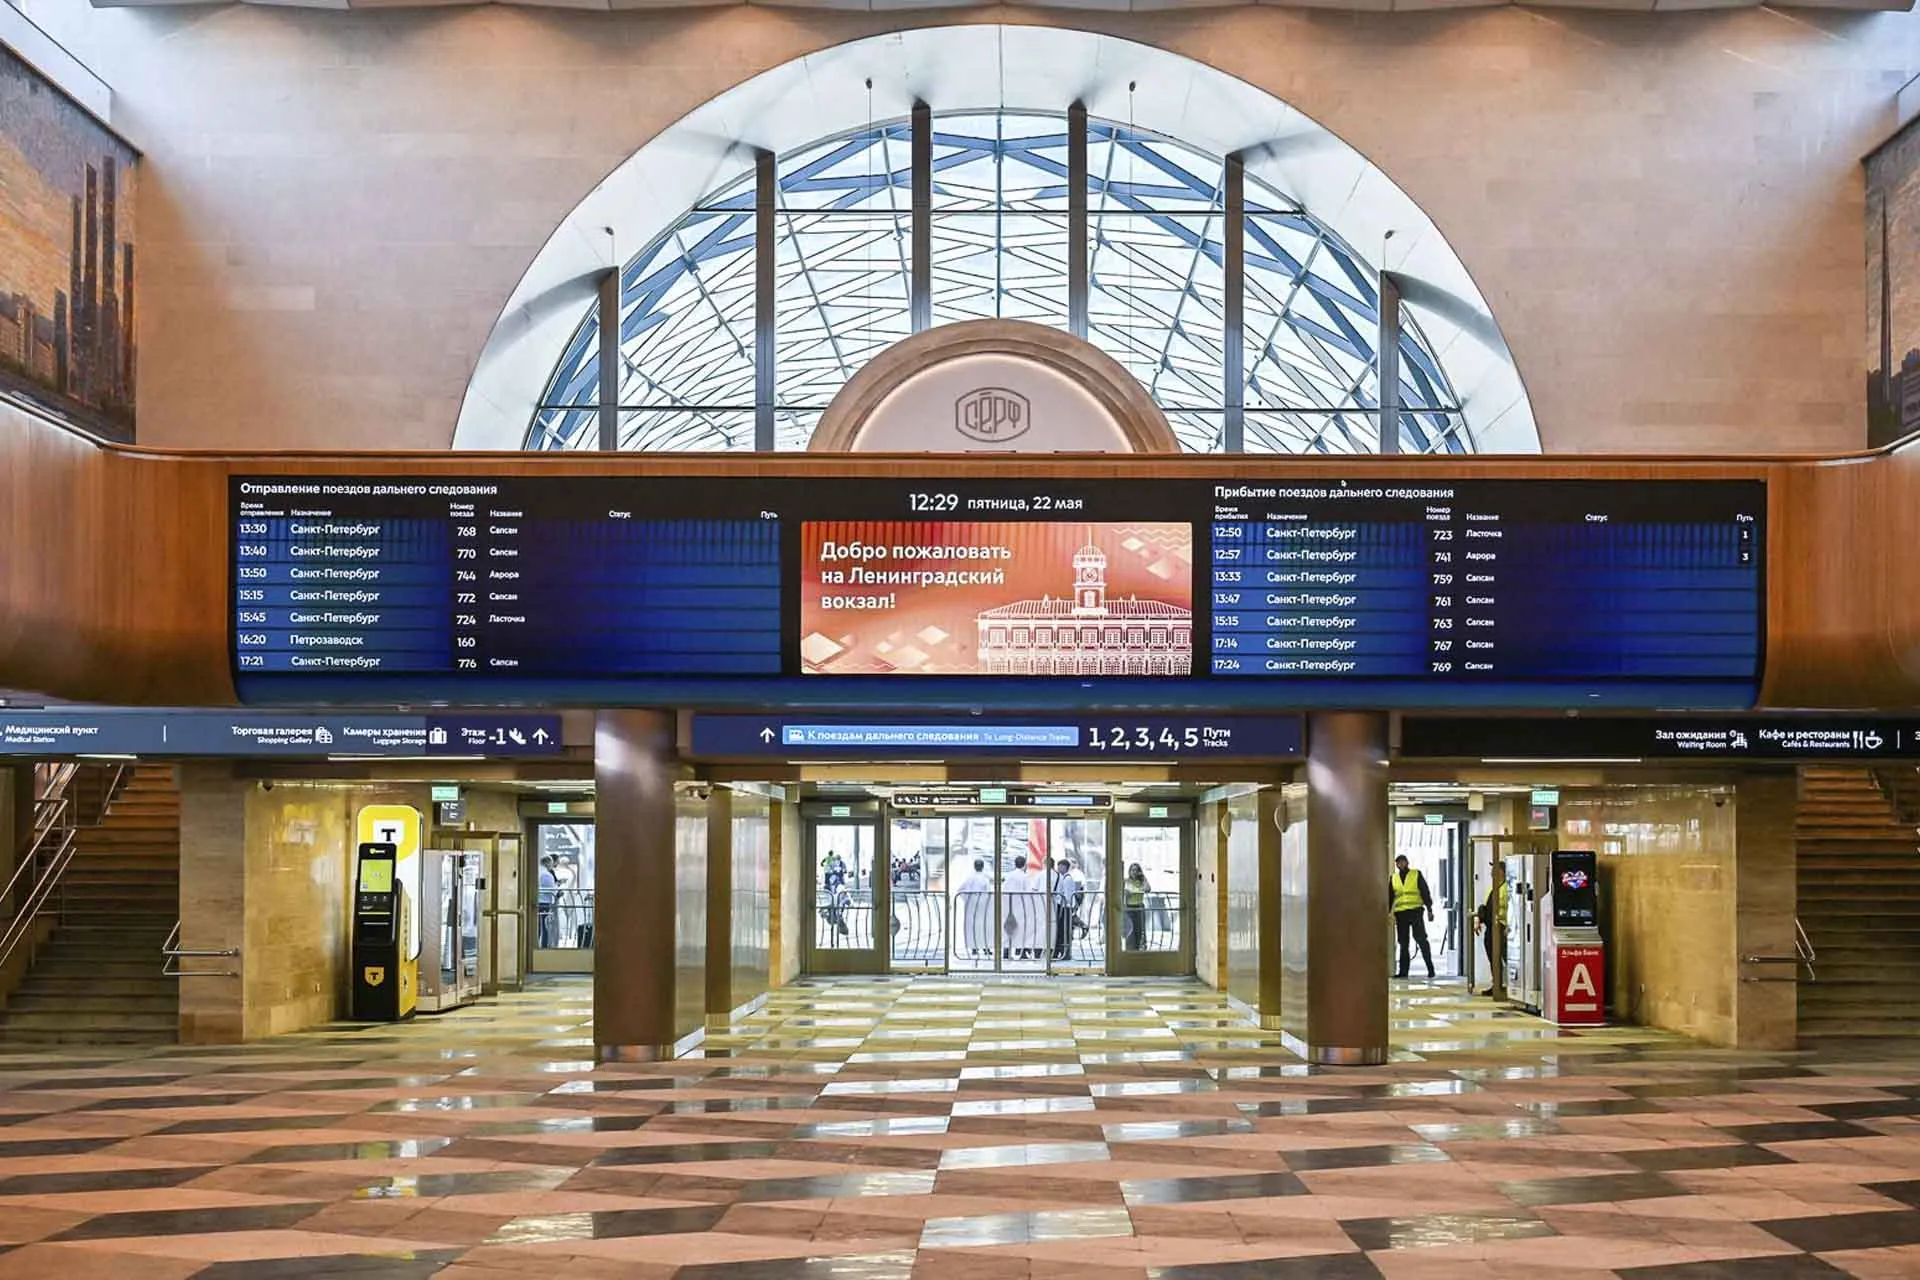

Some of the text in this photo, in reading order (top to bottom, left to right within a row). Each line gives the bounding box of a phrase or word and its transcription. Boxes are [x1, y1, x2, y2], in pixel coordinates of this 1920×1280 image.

[241, 483, 497, 495] Отправление поездов дальнего следования
[1215, 486, 1453, 499] Прибытие поездов дальнего следования
[910, 494, 958, 510] 12:29
[968, 496, 1082, 510] пятница, 22 мая
[1427, 507, 1451, 516] Номер
[240, 524, 267, 533] 13:30
[291, 524, 380, 535] Санкт-Петербург
[458, 527, 476, 536] 768
[490, 526, 517, 534] Сапсан
[1215, 528, 1242, 537] 12:50
[1267, 528, 1356, 539] Санкт-Петербург
[1434, 531, 1452, 540] 723
[240, 546, 266, 555] 13:40
[291, 546, 379, 558] Санкт-Петербург
[457, 549, 476, 558] 770
[490, 548, 517, 556] Сапсан
[821, 542, 1012, 562] Добро пожаловать
[1215, 550, 1240, 559] 12:57
[1267, 550, 1356, 561] Санкт-Петербург
[1435, 552, 1451, 562] 741
[1466, 552, 1496, 560] Аврора
[240, 568, 266, 577] 13:50
[291, 568, 379, 580] Санкт-Петербург
[457, 571, 475, 580] 744
[489, 571, 519, 579] Аврора
[822, 567, 1005, 587] на Ленинградский
[1215, 572, 1241, 581] 13:33
[1267, 572, 1356, 583] Санкт-Петербург
[1434, 575, 1452, 584] 759
[240, 590, 263, 600] 15:15
[290, 591, 379, 602] Санкт-Петербург
[458, 593, 475, 603] 772
[1215, 594, 1240, 603] 13:47
[1267, 594, 1356, 606] Санкт-Петербург
[822, 593, 895, 608] вокзал!
[1435, 597, 1451, 606] 761
[240, 612, 266, 622] 15:45
[290, 613, 379, 624] Санкт-Петербург
[457, 615, 476, 624] 724
[1215, 616, 1238, 625] 15:15
[1267, 616, 1356, 628] Санкт-Петербург
[1434, 619, 1452, 628] 763
[240, 635, 266, 644] 16:20
[290, 635, 363, 646] Петрозаводск
[458, 638, 475, 647] 160
[1214, 638, 1237, 648] 17:14
[1267, 638, 1356, 650] Санкт-Петербург
[1466, 640, 1493, 648] Сапсан
[1434, 641, 1452, 650] 767
[241, 656, 263, 665] 17:21
[291, 656, 380, 667] Санкт-Петербург
[458, 659, 476, 668] 776
[1215, 660, 1239, 669] 17:24
[1266, 660, 1355, 671] Санкт-Петербург
[1433, 663, 1451, 671] 769
[5, 726, 98, 736] Медицинский пункт
[232, 727, 274, 737] Торговая
[344, 728, 426, 737] Камеры хранения
[462, 728, 485, 736] Этаж
[489, 728, 506, 744] -1
[1203, 727, 1230, 739] Пути
[1656, 730, 1726, 740] Зал ожидания
[1759, 730, 1786, 741] Кафе
[1795, 732, 1850, 742] рестораны
[289, 737, 312, 745] Gallery
[816, 732, 864, 742] поездам
[865, 733, 914, 744] дальнего
[917, 733, 979, 743] следования
[1090, 728, 1198, 750] 1, 2, 3, 4, 5
[1203, 737, 1228, 747] Tracks
[1810, 739, 1850, 747] Restaurants
[1677, 739, 1705, 749] Waiting
